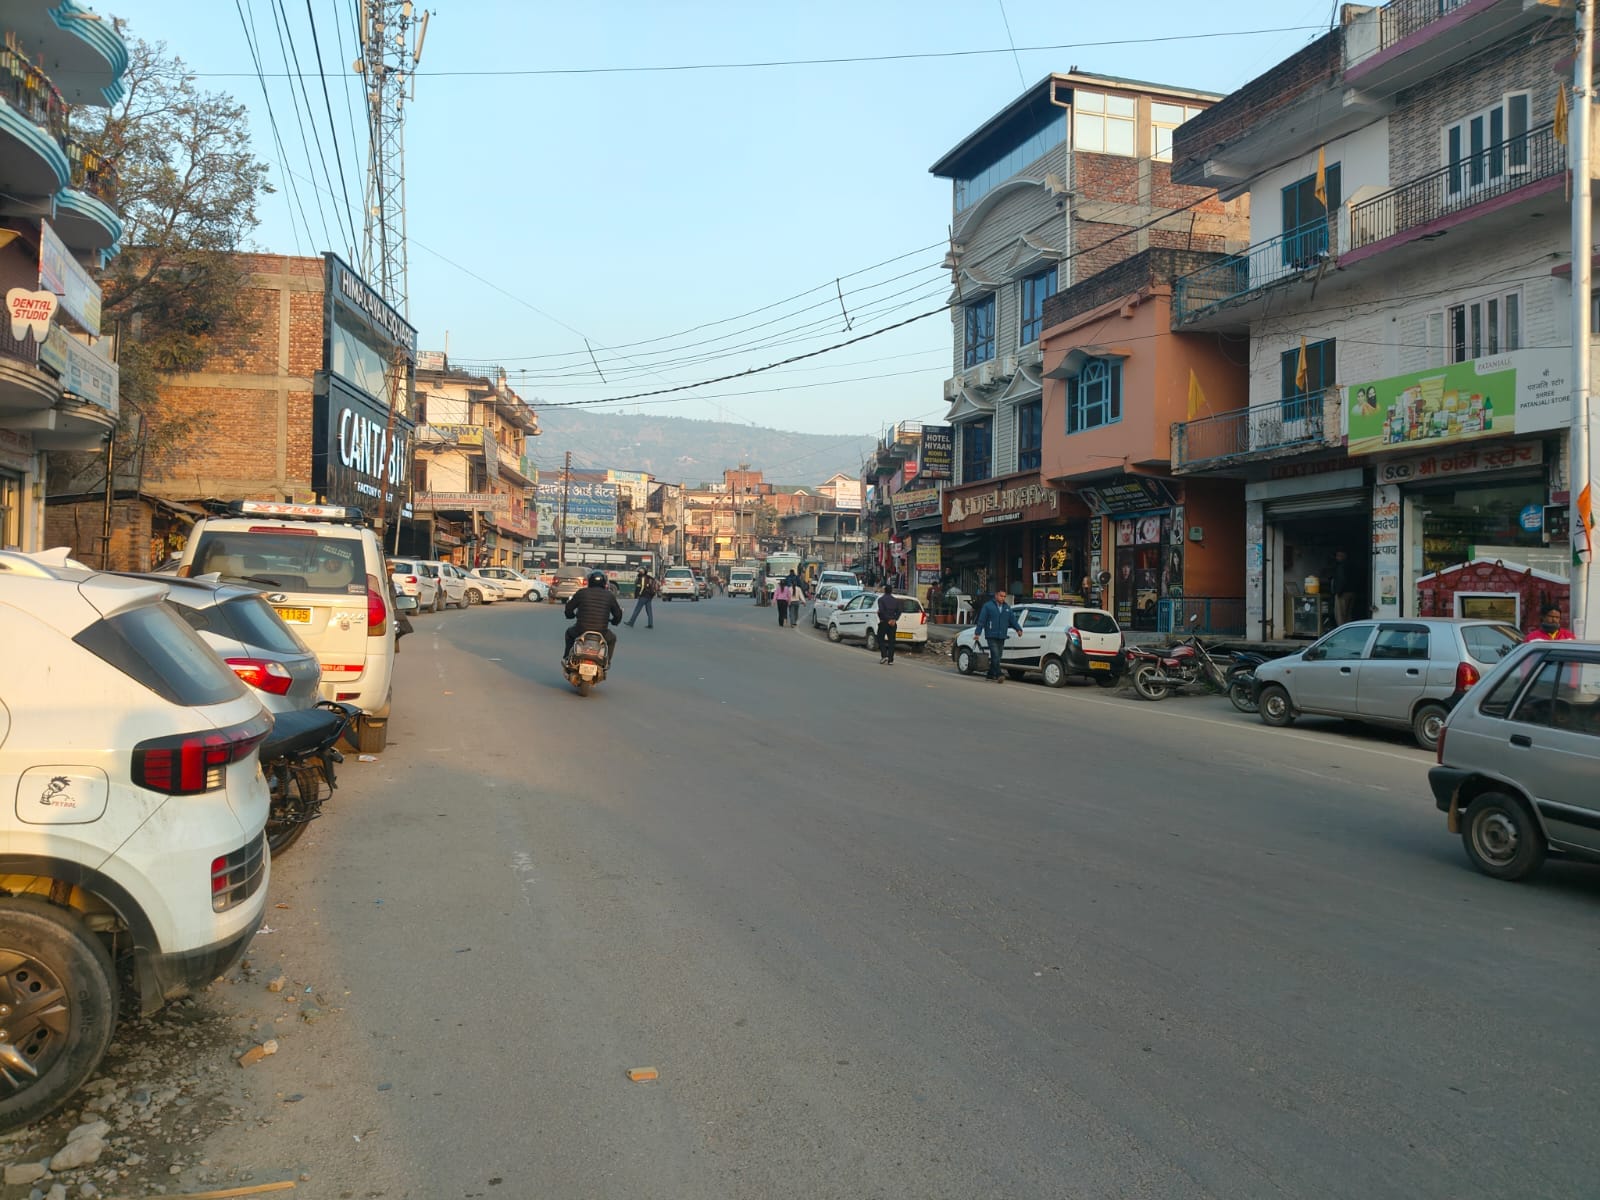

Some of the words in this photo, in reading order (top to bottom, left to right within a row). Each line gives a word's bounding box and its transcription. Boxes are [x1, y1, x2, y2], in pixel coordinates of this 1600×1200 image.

[13, 297, 52, 310] DENTAL
[341, 269, 388, 328] HIMALAYAN
[14, 309, 49, 321] STUDIO
[1535, 390, 1555, 398] SHREE
[1519, 398, 1550, 409] PATANJALI
[1550, 394, 1571, 404] STORE
[926, 434, 951, 442] HOTEL
[924, 442, 952, 450] HIYAAN
[1419, 456, 1437, 475] श्री
[1484, 445, 1532, 464] स्टोर
[1385, 464, 1411, 479] S.G.
[357, 482, 378, 496] FACTORY
[572, 483, 593, 497] आई
[965, 490, 1001, 515] HOTEL
[52, 801, 77, 809] PETROL
